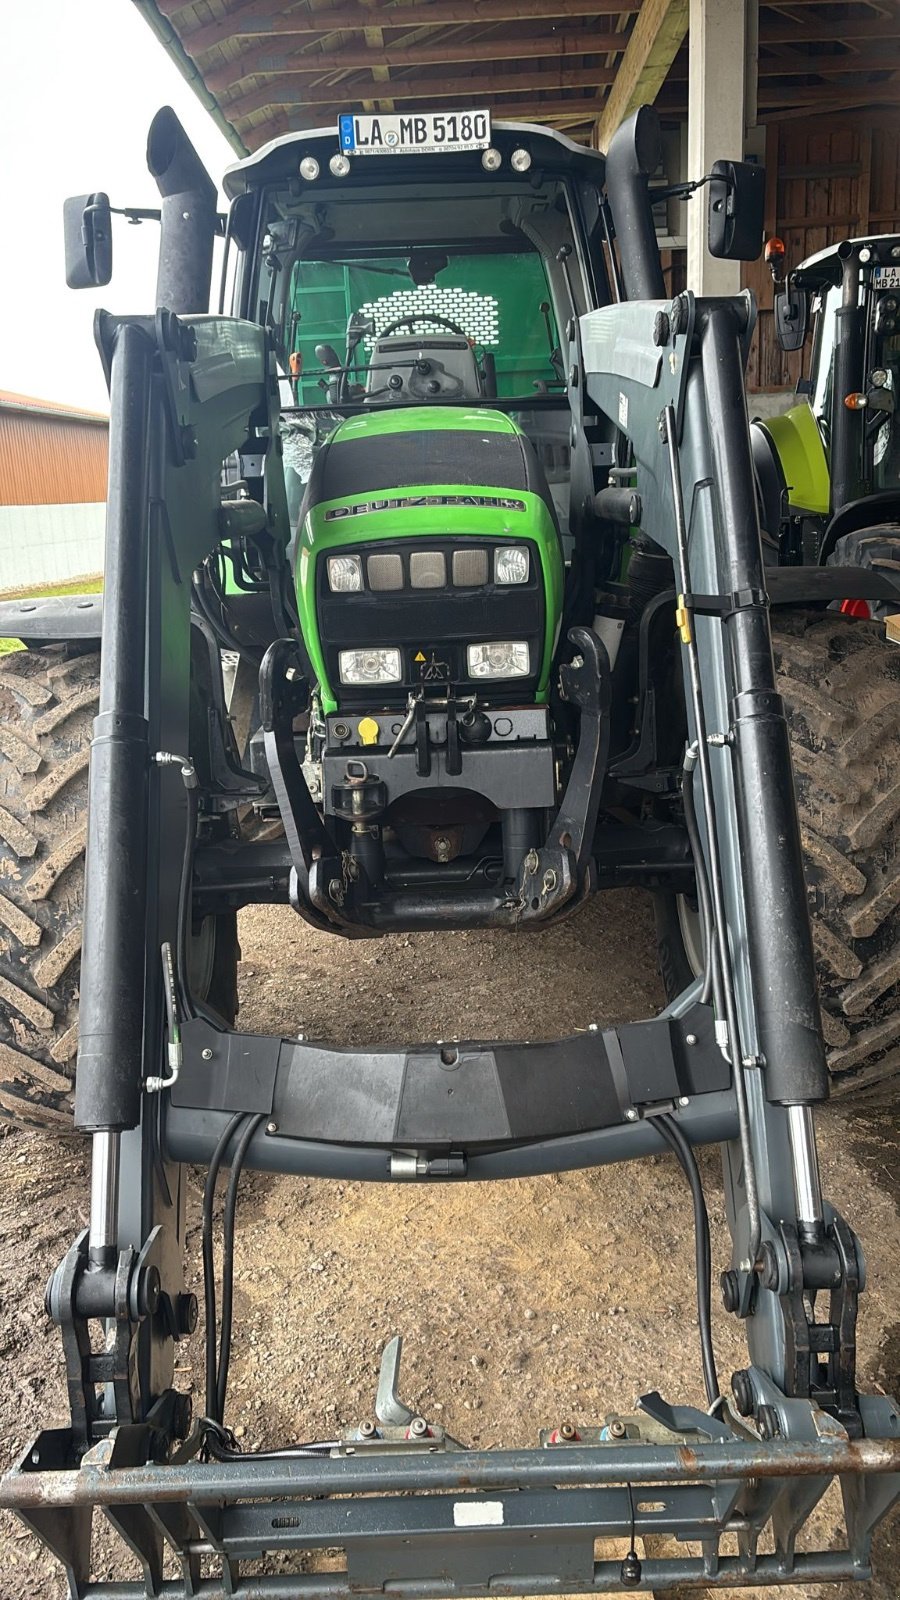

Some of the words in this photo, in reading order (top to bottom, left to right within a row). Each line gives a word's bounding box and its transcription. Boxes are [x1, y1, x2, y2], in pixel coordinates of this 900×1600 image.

[355, 119, 383, 146] LA
[399, 118, 428, 144] MB
[433, 114, 487, 143] 5180
[344, 136, 351, 145] D
[884, 268, 897, 278] LA
[875, 279, 888, 288] MB
